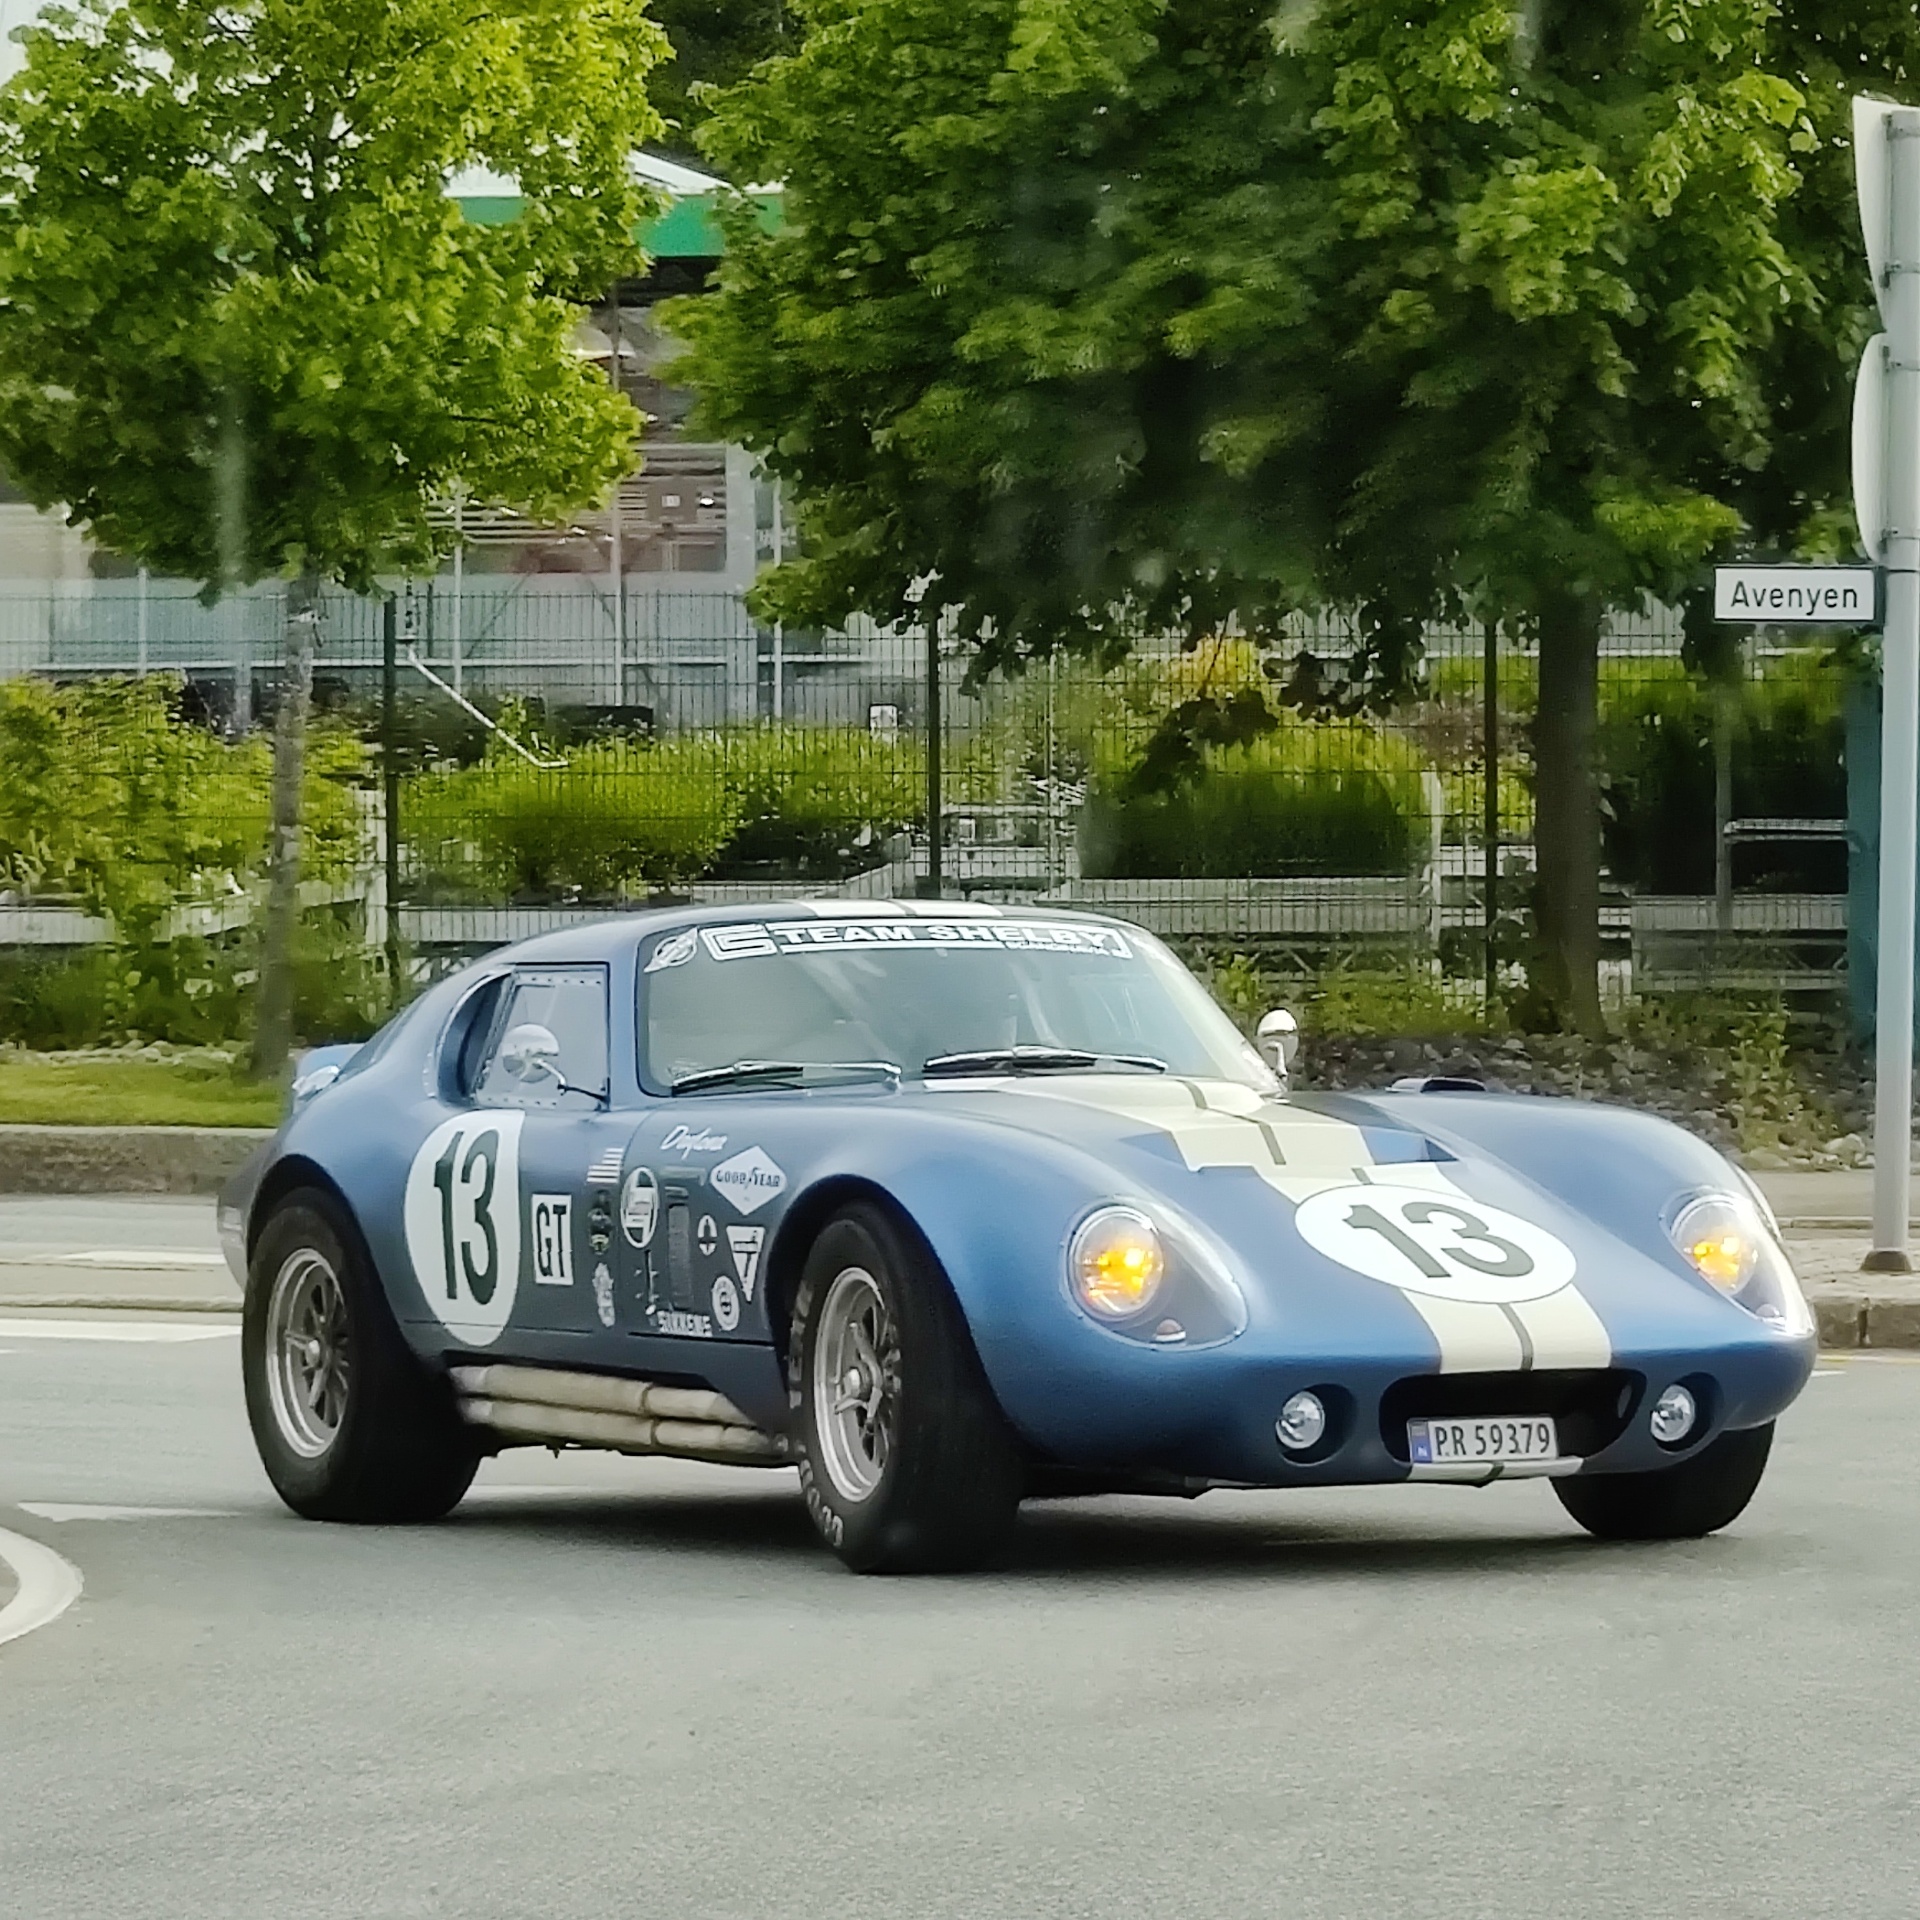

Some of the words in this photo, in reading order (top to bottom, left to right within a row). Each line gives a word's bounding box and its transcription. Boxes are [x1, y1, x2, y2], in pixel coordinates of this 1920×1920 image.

[1732, 580, 1858, 616] Avenyen
[774, 926, 916, 943] TEAM
[928, 925, 1107, 947] SHELBY
[434, 1130, 500, 1305] 13
[537, 1203, 567, 1277] GT
[1342, 1202, 1534, 1277] 13
[1434, 1426, 1466, 1456] PR
[1475, 1423, 1550, 1455] 59379
